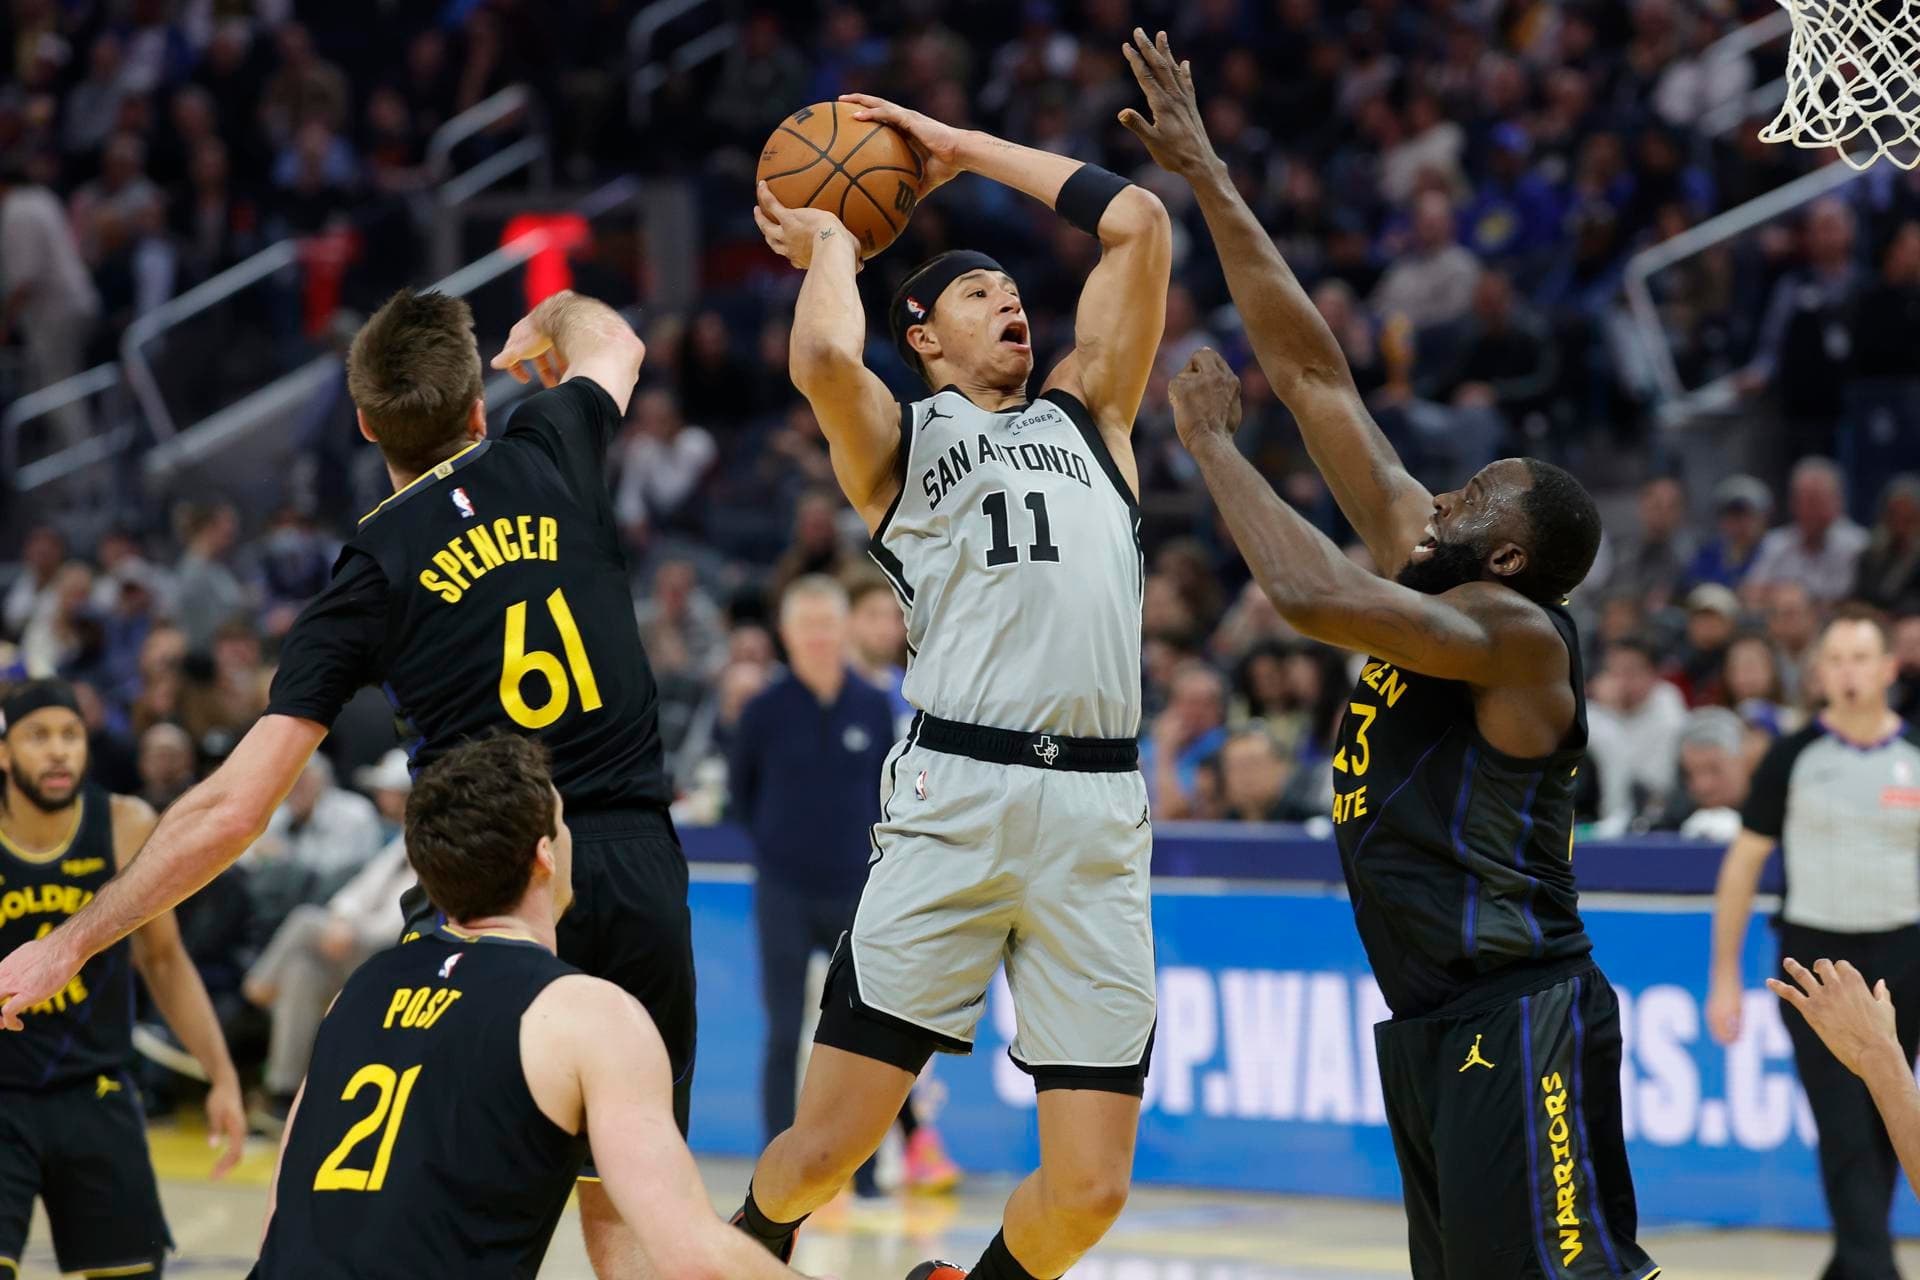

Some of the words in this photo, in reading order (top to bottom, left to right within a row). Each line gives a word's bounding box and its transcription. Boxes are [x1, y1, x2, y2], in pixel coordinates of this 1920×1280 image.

[1016, 413, 1054, 431] LEDGER
[921, 440, 973, 512] SAN
[418, 514, 558, 604] SPENCER
[981, 489, 1061, 568] 11
[499, 587, 603, 729] 61
[0, 884, 95, 929] OLDE
[383, 986, 462, 1029] POST
[312, 1063, 423, 1192] 21
[1541, 1071, 1584, 1268] WARRIORS
